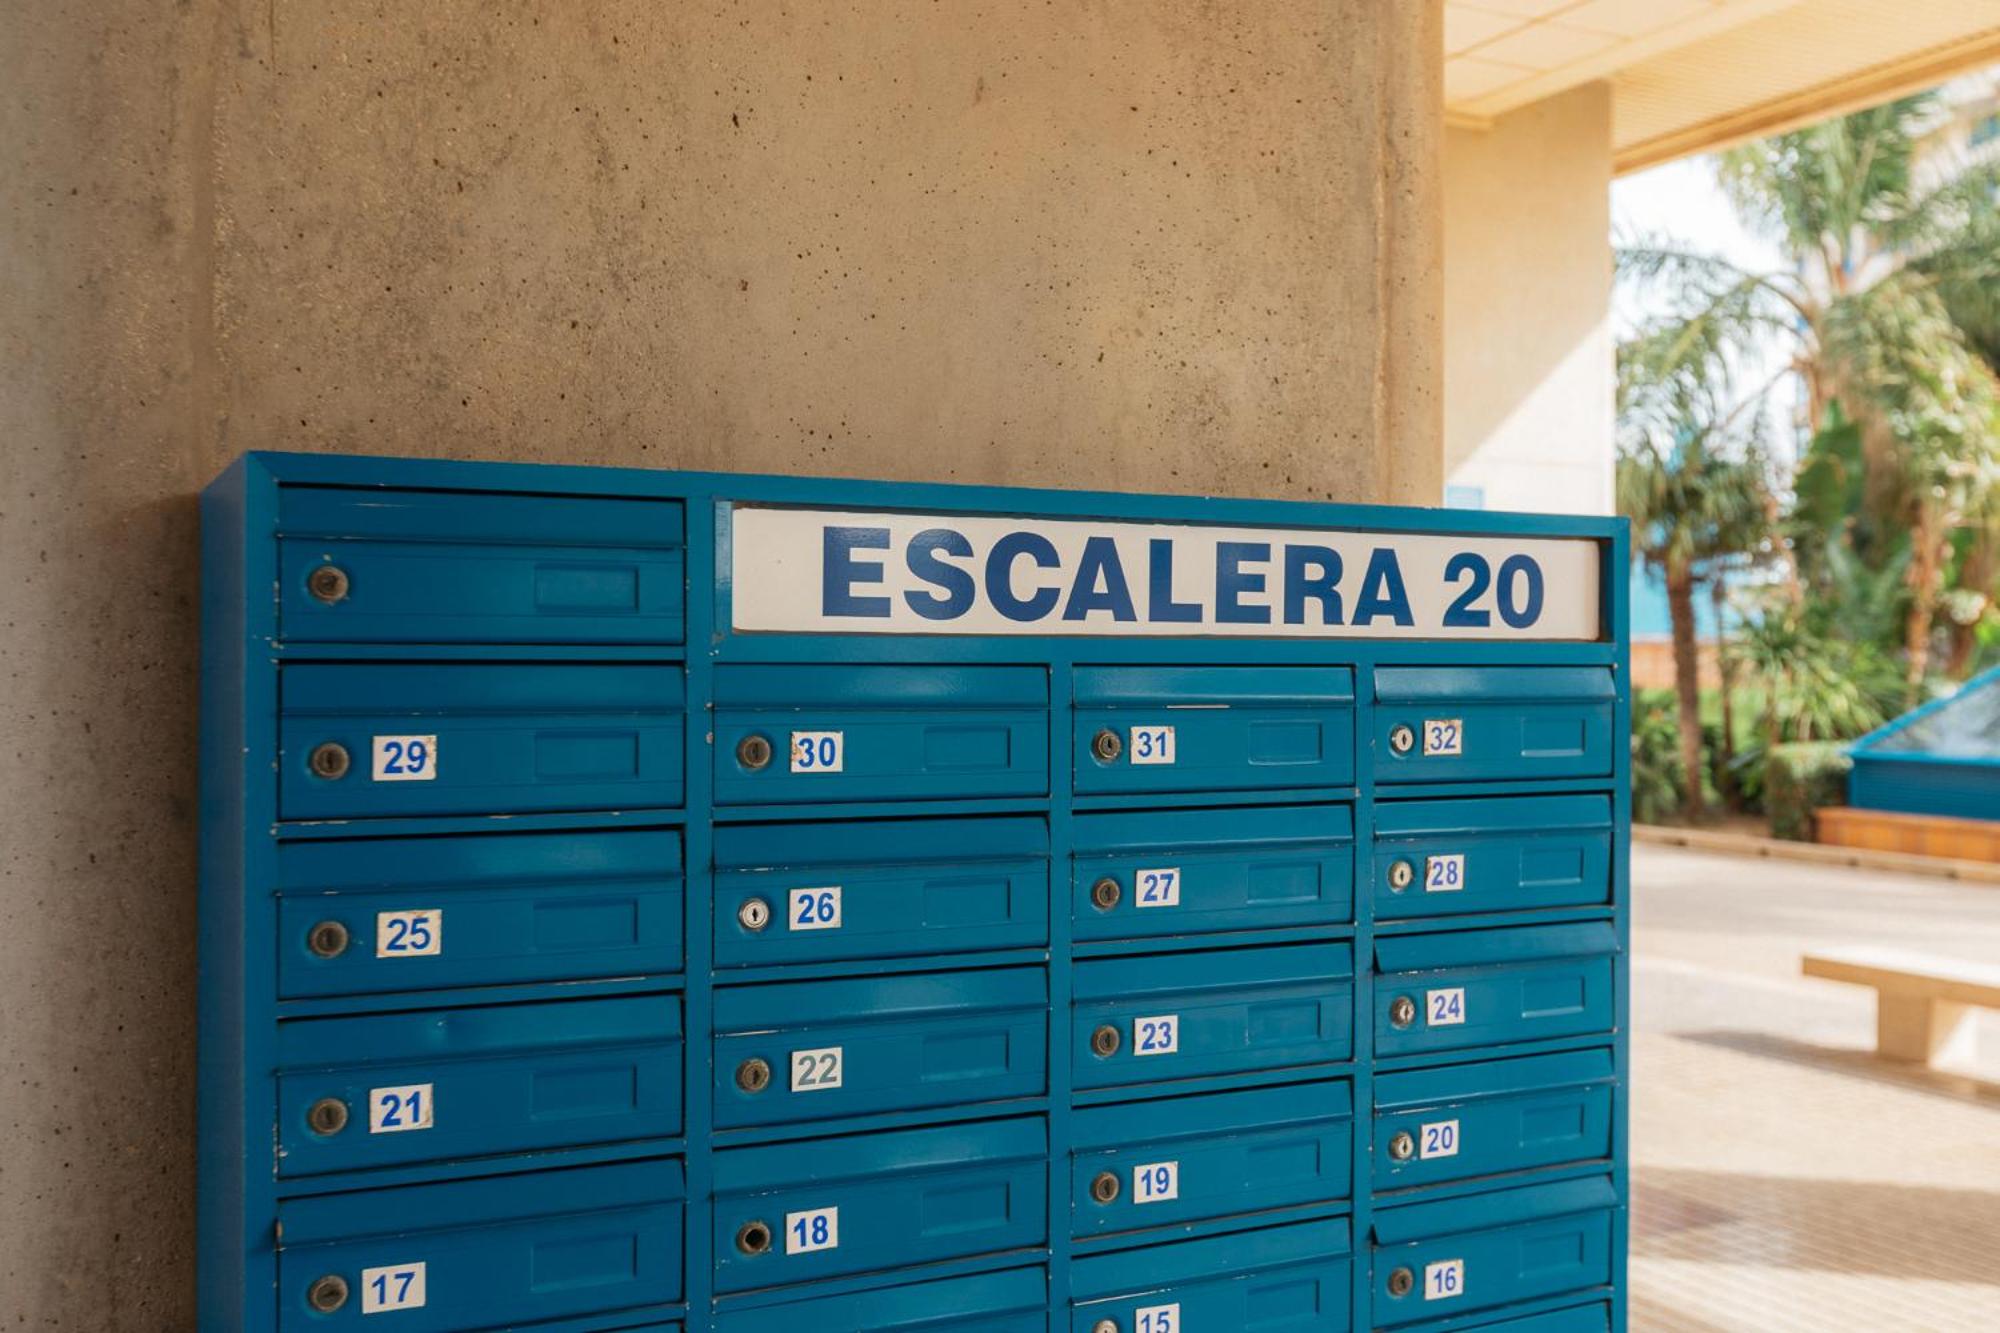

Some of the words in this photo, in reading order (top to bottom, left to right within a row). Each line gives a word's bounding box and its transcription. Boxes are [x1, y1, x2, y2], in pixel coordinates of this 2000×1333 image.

[823, 527, 1414, 626] ESCALERA
[1443, 553, 1543, 628] 20
[798, 736, 836, 768] 30
[1137, 731, 1166, 758] 31
[1430, 724, 1457, 751] 32
[383, 740, 428, 774] 29
[1143, 873, 1174, 902] 27
[1431, 860, 1458, 886] 28
[797, 892, 835, 924] 26
[385, 916, 431, 951] 25
[1434, 993, 1460, 1020] 24
[1141, 1021, 1172, 1051] 23
[798, 1053, 837, 1086] 22
[380, 1091, 421, 1128] 21
[1427, 1125, 1453, 1153] 20
[1141, 1167, 1170, 1196] 19
[793, 1215, 829, 1247] 18
[371, 1271, 415, 1305] 17
[1434, 1266, 1456, 1293] 16
[1140, 1310, 1170, 1333] 15
